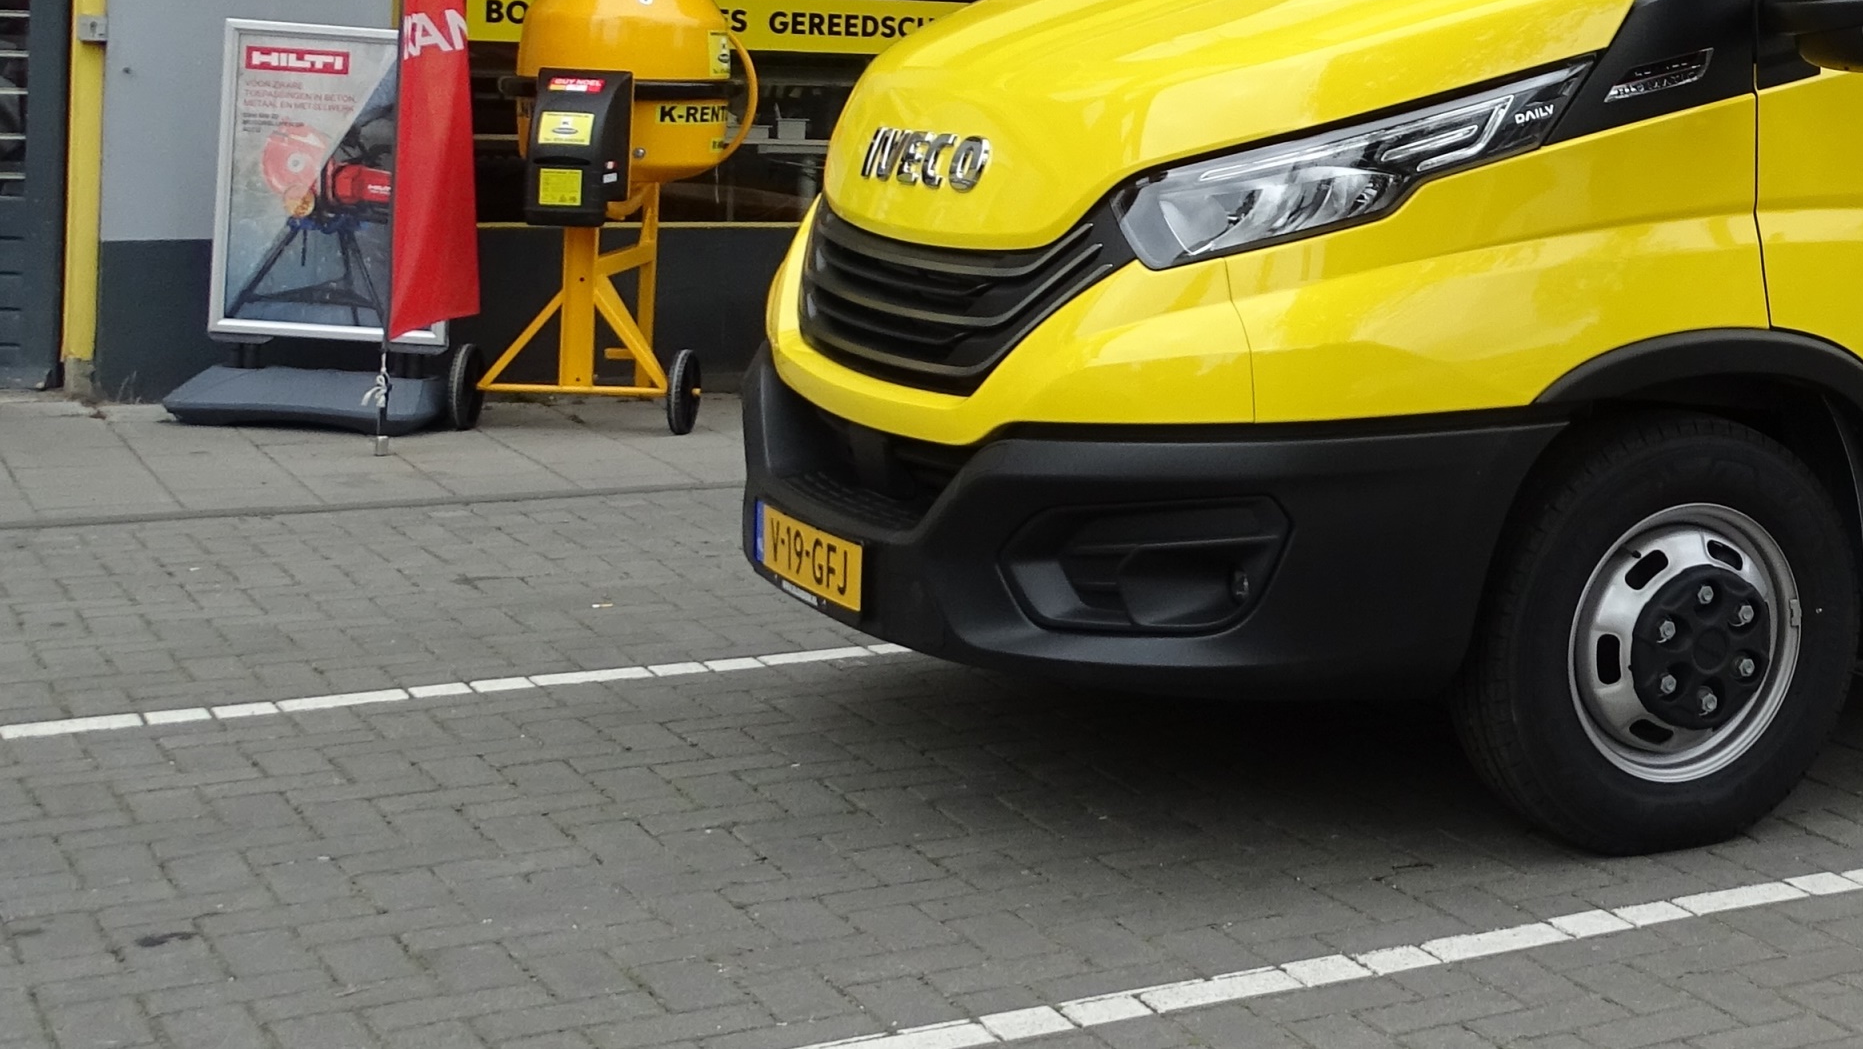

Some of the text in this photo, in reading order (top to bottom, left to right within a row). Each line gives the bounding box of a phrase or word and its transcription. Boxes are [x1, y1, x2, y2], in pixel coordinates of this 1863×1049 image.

[251, 50, 344, 70] HILTI
[660, 105, 728, 123] K-RENT
[1514, 104, 1555, 124] DAILY
[860, 126, 992, 193] IVECO
[771, 517, 848, 596] V-19-GFJ
